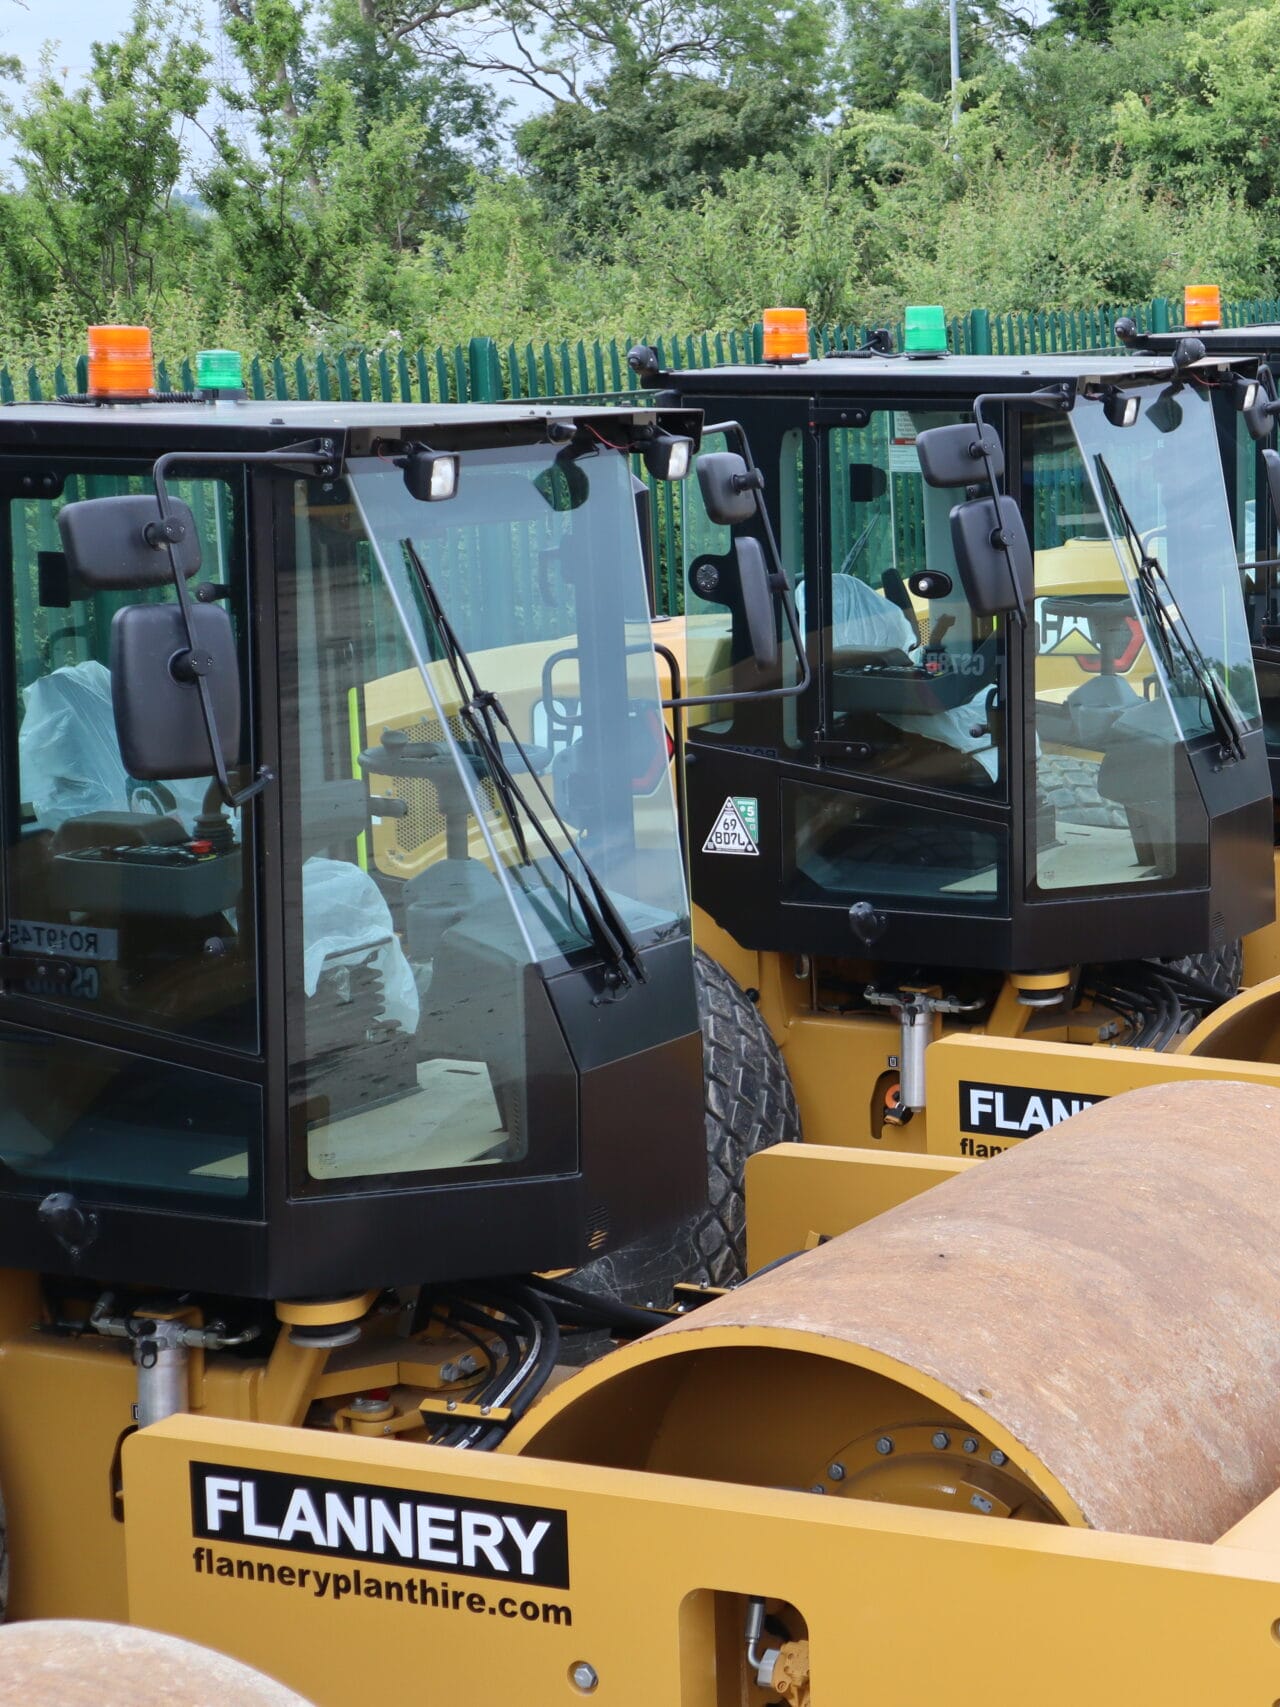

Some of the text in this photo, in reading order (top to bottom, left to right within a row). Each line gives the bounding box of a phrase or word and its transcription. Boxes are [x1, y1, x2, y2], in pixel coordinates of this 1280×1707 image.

[723, 818, 737, 831] 69
[747, 806, 755, 817] 5
[969, 1088, 1095, 1132] FLAN
[204, 1476, 551, 1576] FLANNERY
[192, 1546, 573, 1627] flanneryplanthire.com
